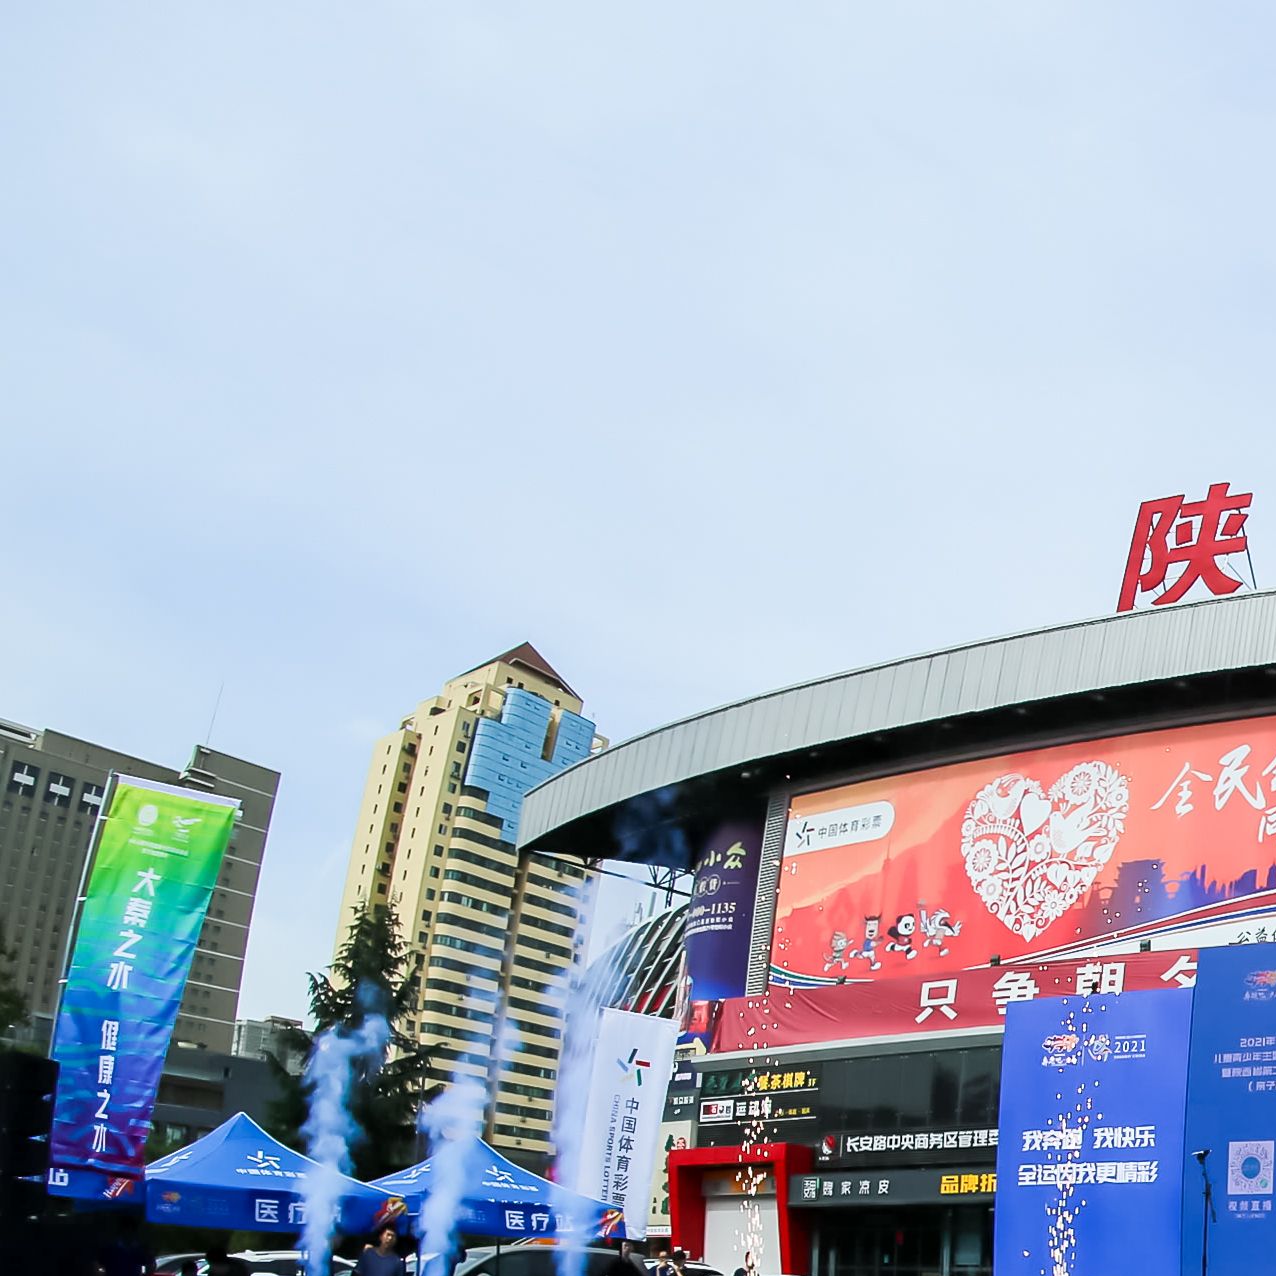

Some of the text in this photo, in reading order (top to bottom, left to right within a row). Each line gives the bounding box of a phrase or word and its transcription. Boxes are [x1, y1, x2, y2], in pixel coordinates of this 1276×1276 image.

[817, 814, 883, 839] 中国体育彩票
[914, 954, 1199, 1025] 只争朝夕
[1114, 1039, 1146, 1055] 2021
[1022, 1125, 1156, 1151] 我奔跑 我快乐
[611, 1097, 640, 1208] 中国体育彩票
[1228, 1199, 1272, 1212] 视频直播
